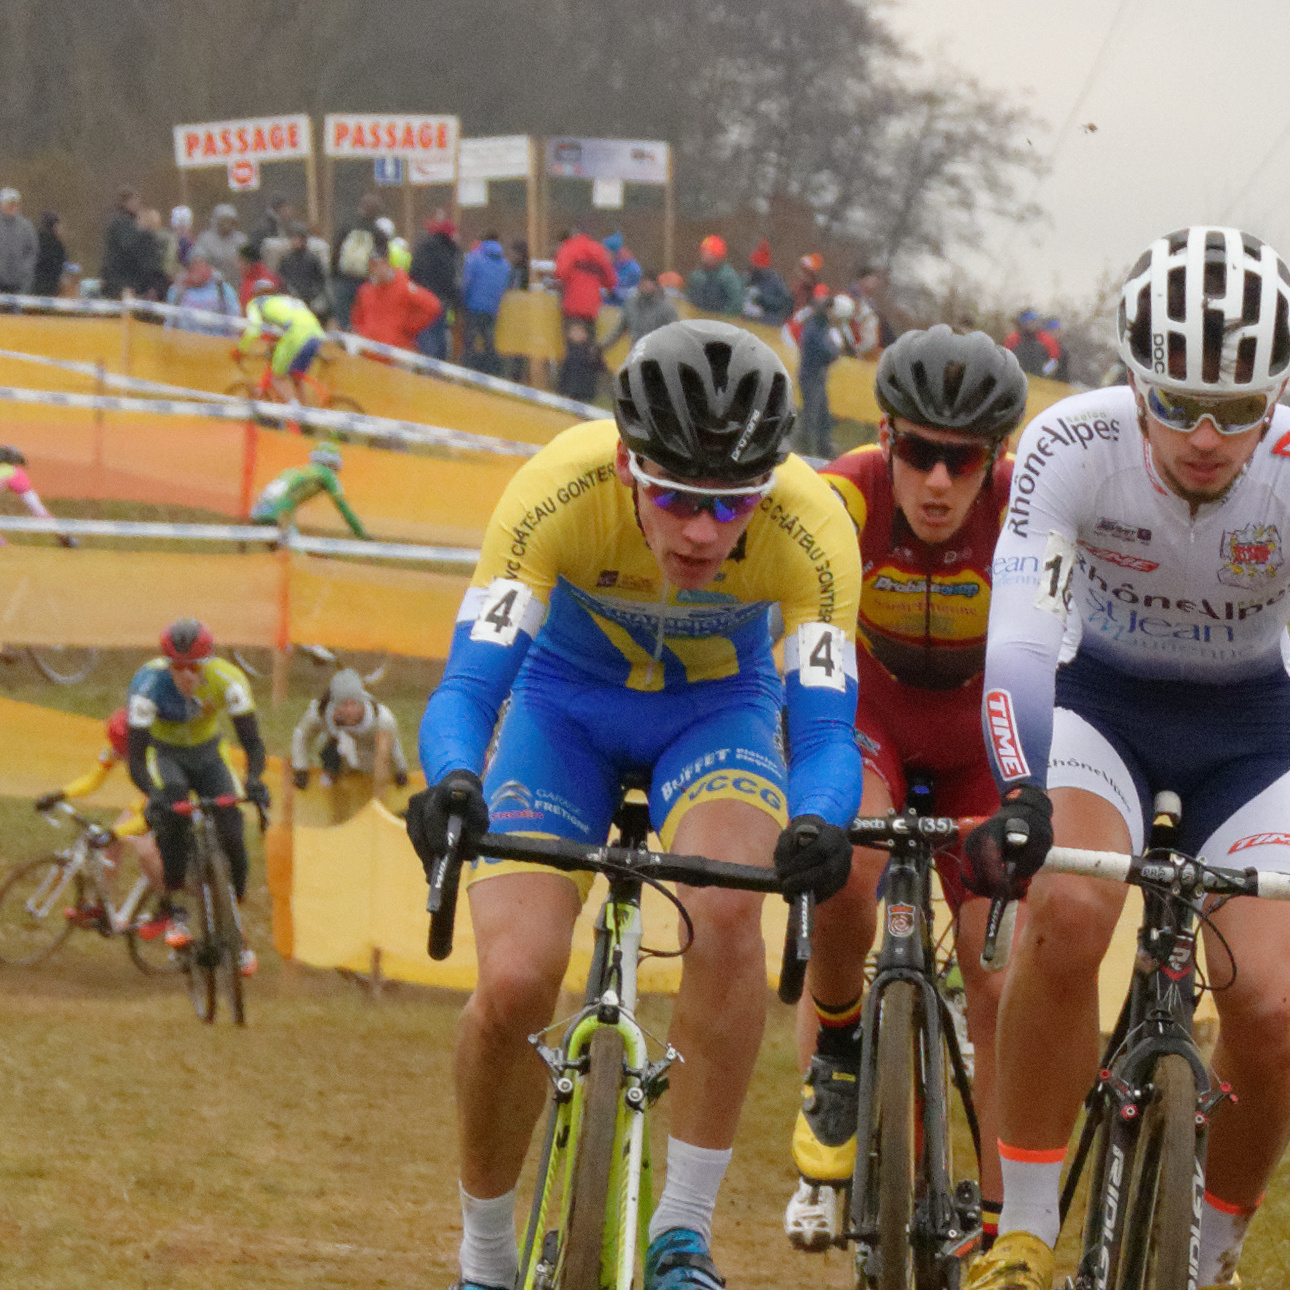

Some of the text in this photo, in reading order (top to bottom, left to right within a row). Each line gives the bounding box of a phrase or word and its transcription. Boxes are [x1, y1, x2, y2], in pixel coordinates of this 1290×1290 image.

[184, 123, 299, 158] PASSAGE
[333, 122, 449, 149] PASSAGE
[485, 588, 518, 633] 4
[809, 630, 835, 677] 4
[987, 693, 1025, 779] TIME
[801, 893, 809, 938] TEGRA
